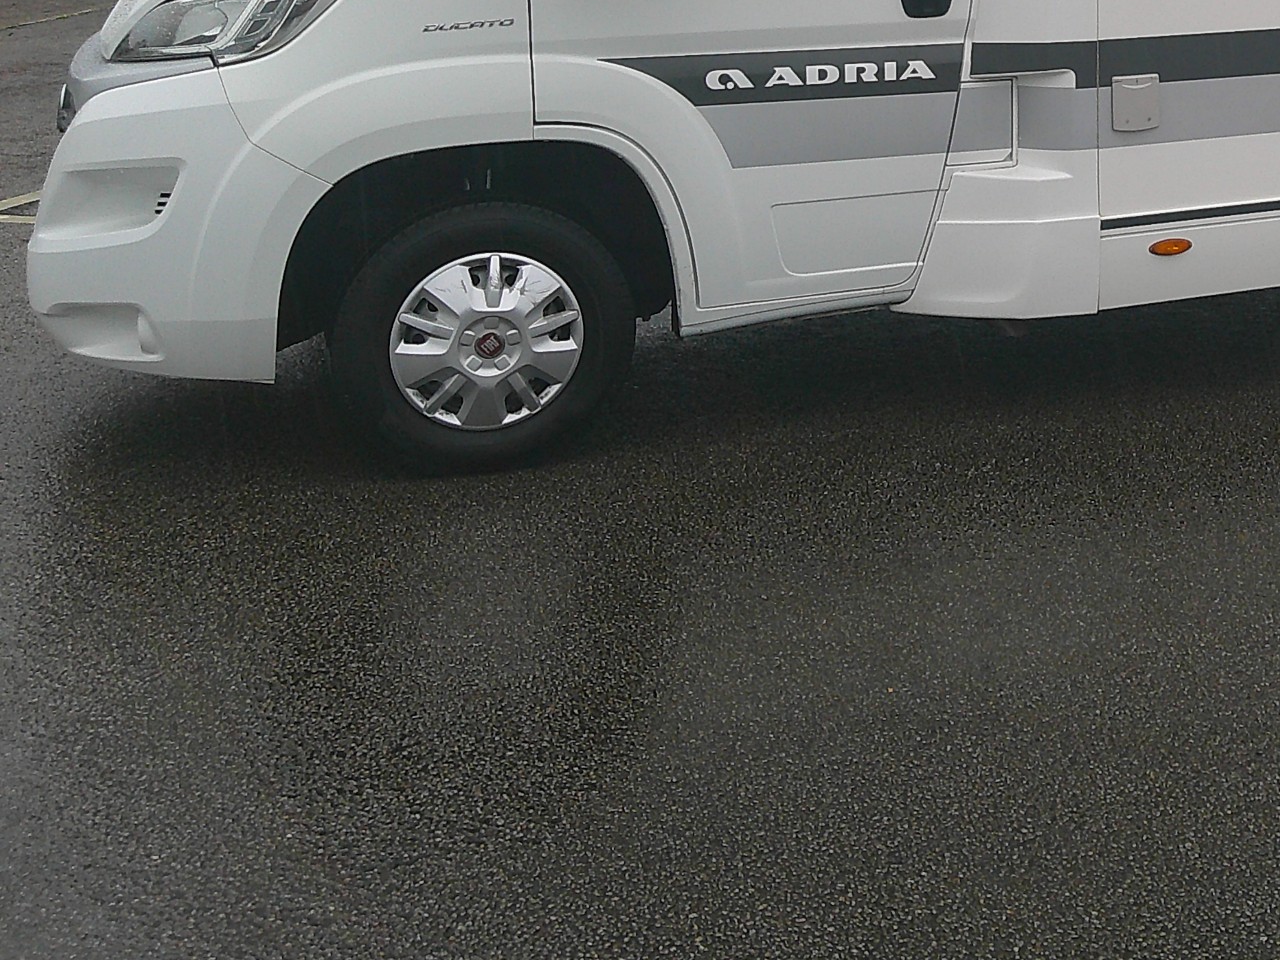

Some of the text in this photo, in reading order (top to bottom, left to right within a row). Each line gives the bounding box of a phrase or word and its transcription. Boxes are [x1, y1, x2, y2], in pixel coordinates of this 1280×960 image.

[422, 19, 514, 32] DUCATO
[765, 59, 936, 88] ADRIA
[480, 336, 499, 354] FIAT
